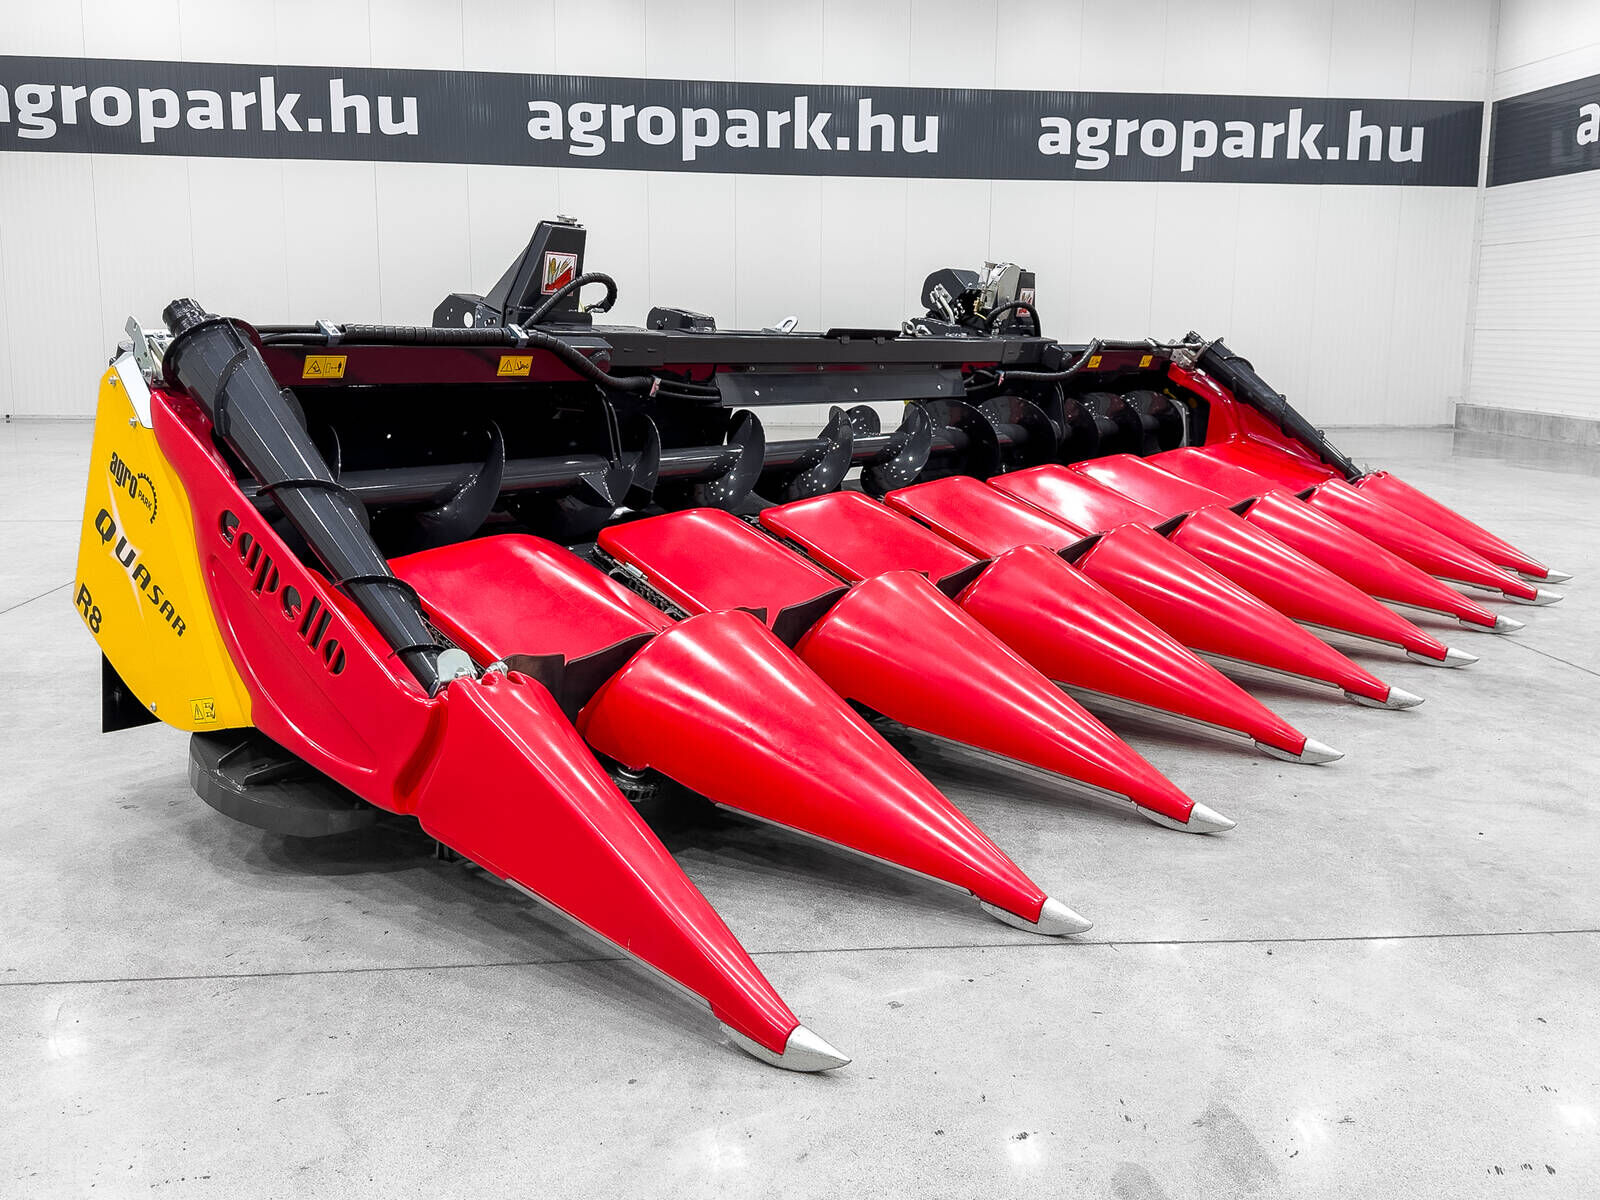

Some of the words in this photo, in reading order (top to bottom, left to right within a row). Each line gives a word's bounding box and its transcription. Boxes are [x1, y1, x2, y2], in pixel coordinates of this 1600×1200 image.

[527, 95, 939, 162] agropark.hu
[1037, 108, 1425, 173] agropark.hu
[109, 451, 138, 499] agro
[137, 489, 153, 511] PARK
[95, 508, 187, 637] QUASAR
[218, 509, 347, 677] capello
[76, 582, 102, 635] R8
